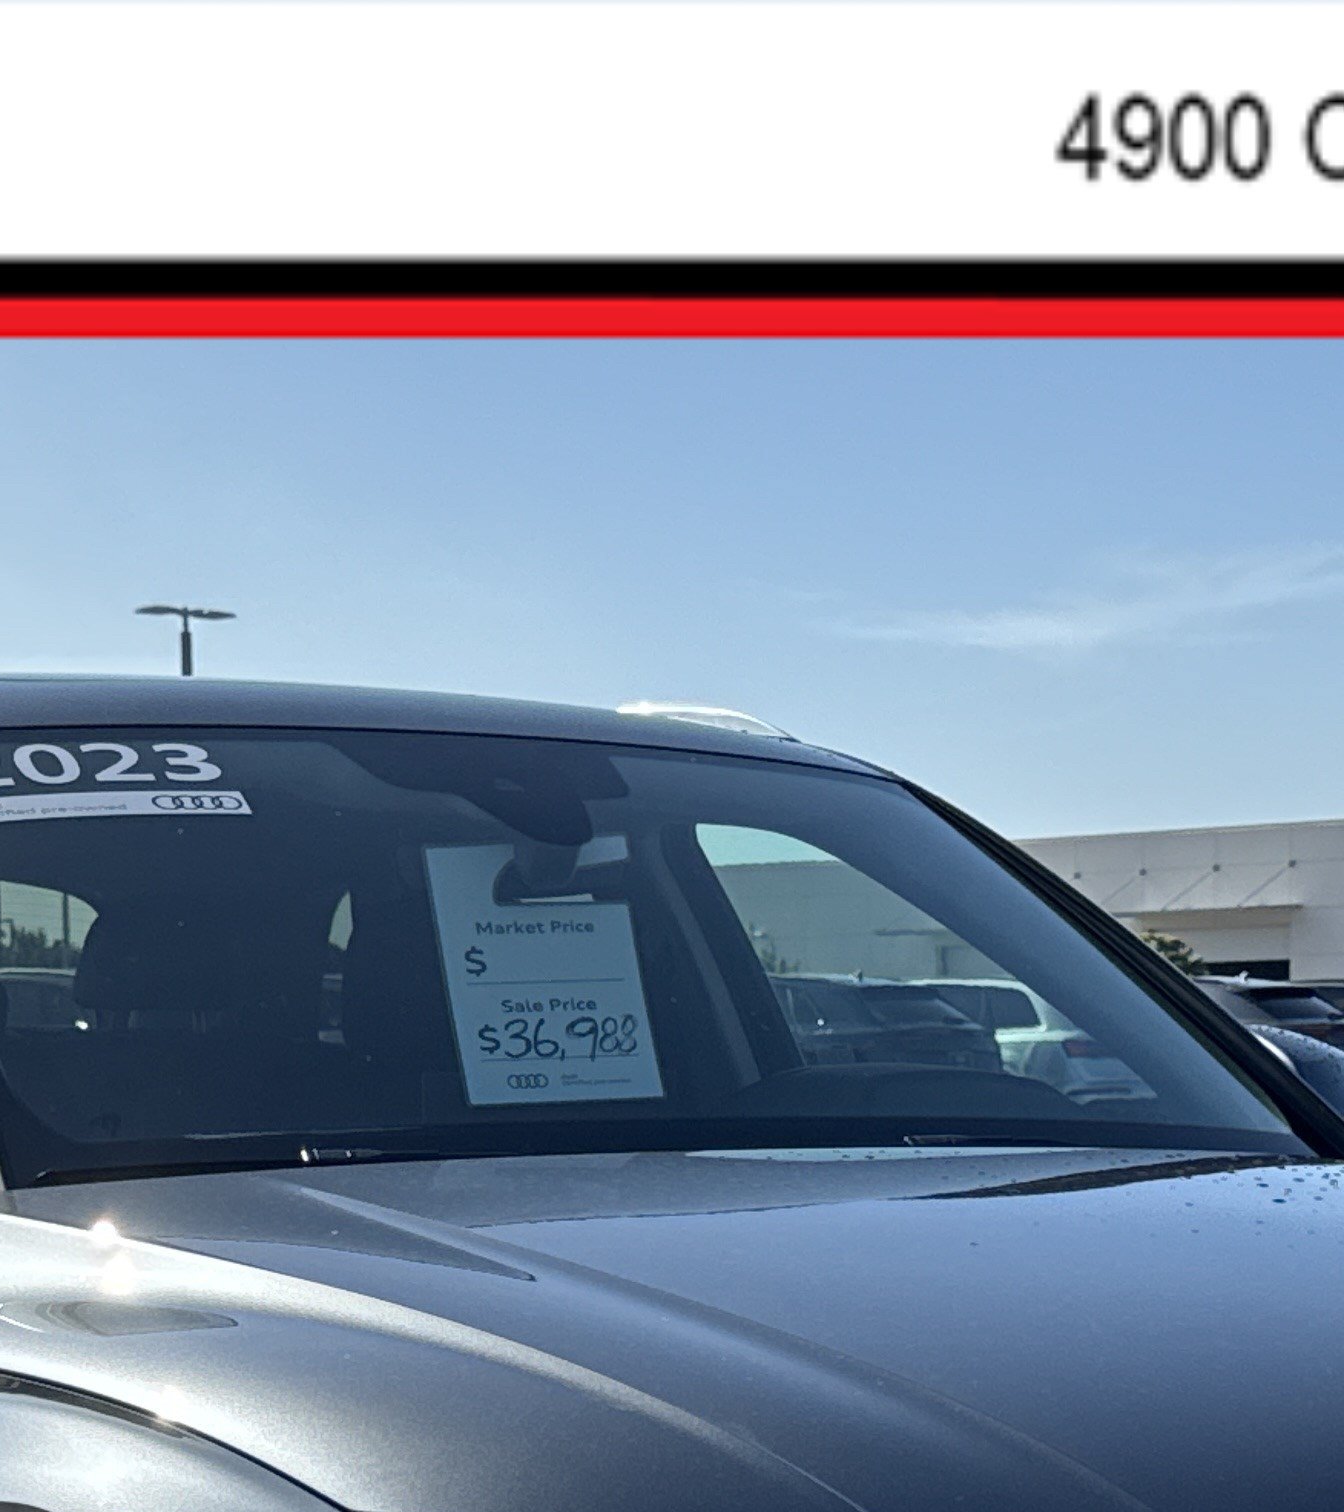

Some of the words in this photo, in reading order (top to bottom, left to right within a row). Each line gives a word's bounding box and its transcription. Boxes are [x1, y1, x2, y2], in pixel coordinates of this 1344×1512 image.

[475, 922, 545, 935] Market
[550, 920, 595, 933] Price
[464, 945, 488, 977] $
[501, 998, 543, 1013] Sale
[549, 997, 598, 1011] Price
